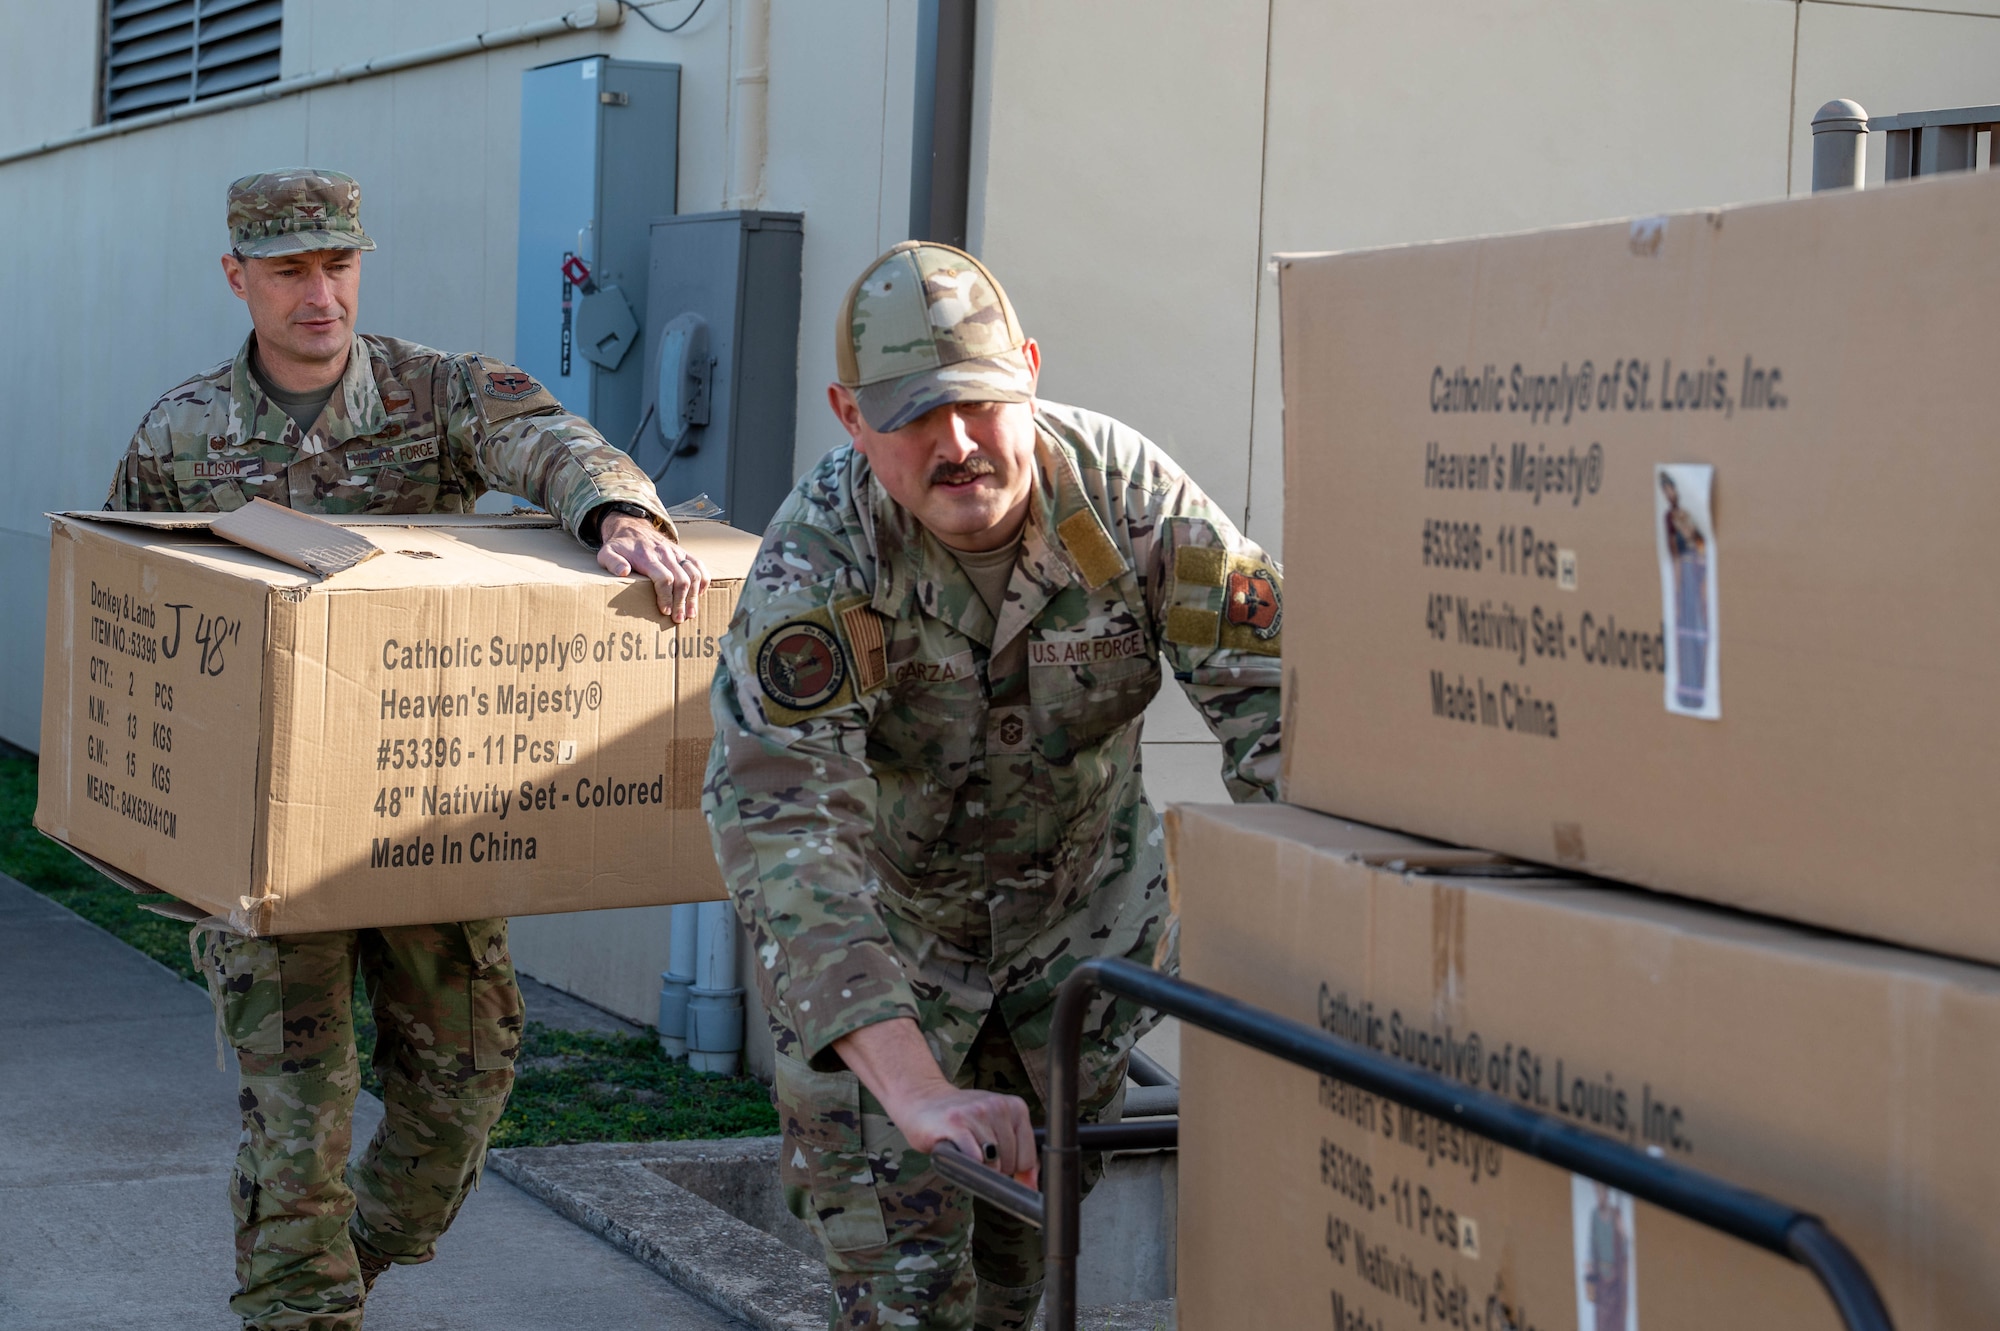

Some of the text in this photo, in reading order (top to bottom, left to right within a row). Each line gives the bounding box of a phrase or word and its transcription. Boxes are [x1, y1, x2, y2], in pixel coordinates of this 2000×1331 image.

[1430, 354, 1789, 424] Catholic Supply® of St. Louis, Inc.
[194, 461, 241, 477] ELLISON
[353, 441, 434, 467] U.S. AIR FORCE
[1424, 441, 1603, 507] Heaven's Majesty®
[1421, 518, 1482, 572] #53396
[1496, 524, 1516, 575] 11
[1521, 526, 1558, 579] Pcs
[1561, 558, 1575, 586] H
[91, 581, 156, 629] Donkey & Lamb
[91, 616, 111, 646] ITEM
[195, 613, 241, 677] 48"
[382, 637, 482, 670] Catholic
[489, 633, 588, 673] Supply®
[593, 631, 615, 662] of
[620, 631, 648, 661] St.
[1033, 633, 1142, 664] U.S. AIR FORCE
[1426, 592, 1452, 640] 48"
[1455, 596, 1527, 666] Nativity
[1531, 604, 1567, 661] Set
[1580, 611, 1666, 674] Colored
[129, 671, 134, 696] 2
[154, 682, 173, 712] PCS
[895, 662, 957, 683] GARZA
[380, 680, 602, 721] Heaven's Majesty®
[1430, 669, 1559, 740] Made In China
[127, 712, 137, 740] 13
[152, 721, 172, 753] KGS
[376, 736, 462, 771] #53396
[483, 734, 505, 766] 11
[565, 745, 573, 760] J
[126, 750, 136, 778] 15
[151, 762, 171, 794] KGS
[121, 791, 177, 839] 84X63X41CM
[373, 786, 415, 819] 48"
[421, 782, 512, 820] Nativity
[518, 780, 557, 812] Set
[575, 775, 664, 809] Colored
[370, 831, 537, 868] Made In China
[1318, 981, 1384, 1051] Catholic
[1488, 1041, 1513, 1093] of
[1516, 1047, 1549, 1107] St.
[1643, 1082, 1693, 1153] Inc.
[1319, 1137, 1375, 1212] #53396
[1391, 1175, 1412, 1230] 11
[1418, 1184, 1459, 1249] Pcs
[1463, 1225, 1475, 1247] A
[1325, 1212, 1351, 1265] 48"
[1354, 1228, 1428, 1325] Nativity
[1432, 1267, 1469, 1331] Set
